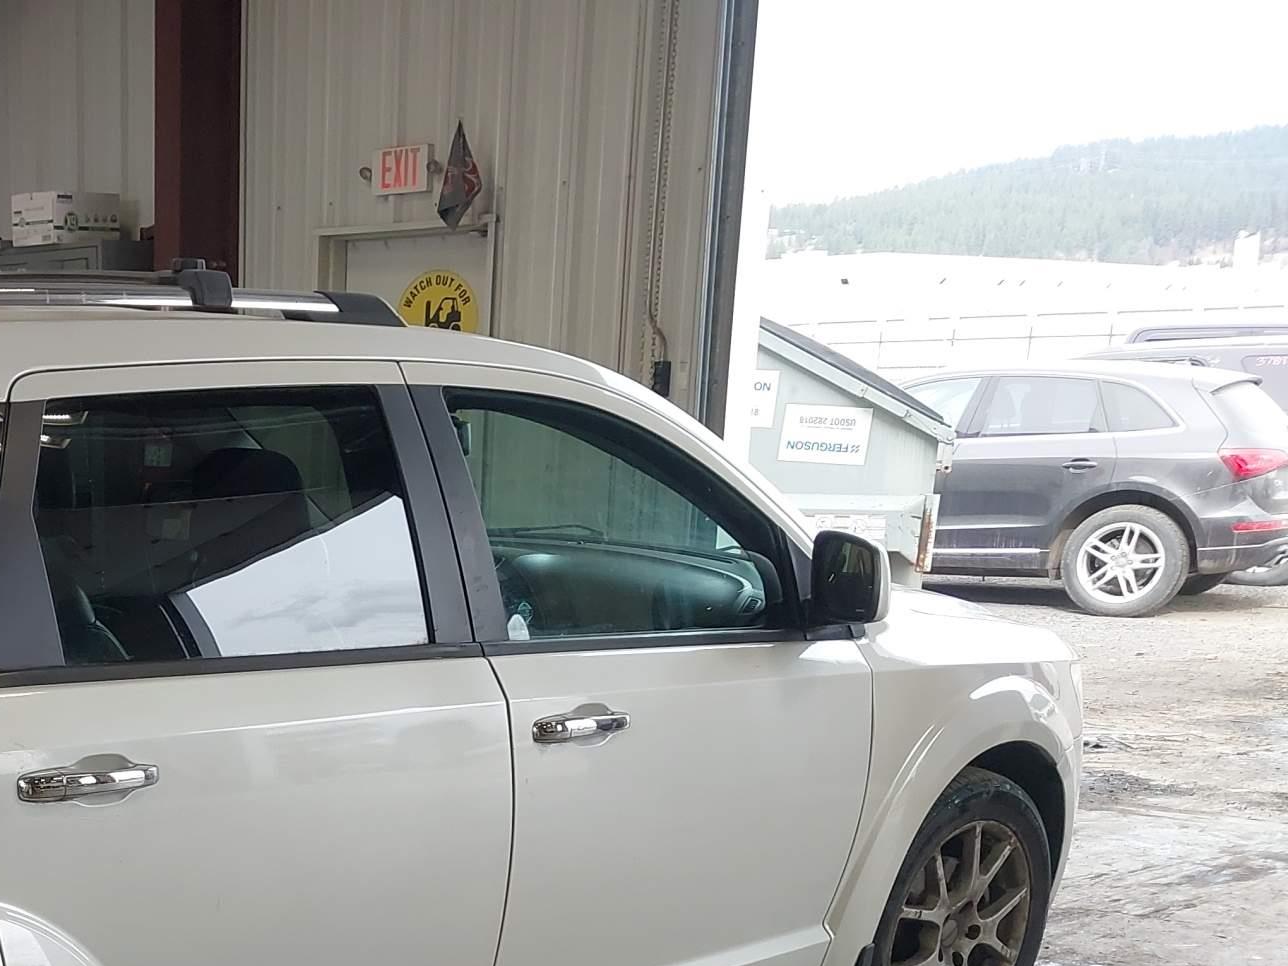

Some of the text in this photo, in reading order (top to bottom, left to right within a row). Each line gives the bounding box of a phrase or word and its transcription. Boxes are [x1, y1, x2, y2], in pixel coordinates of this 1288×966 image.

[381, 148, 421, 189] EXIT
[403, 274, 472, 308] WATCH OUT FOR
[786, 440, 849, 453] FERGUSON
